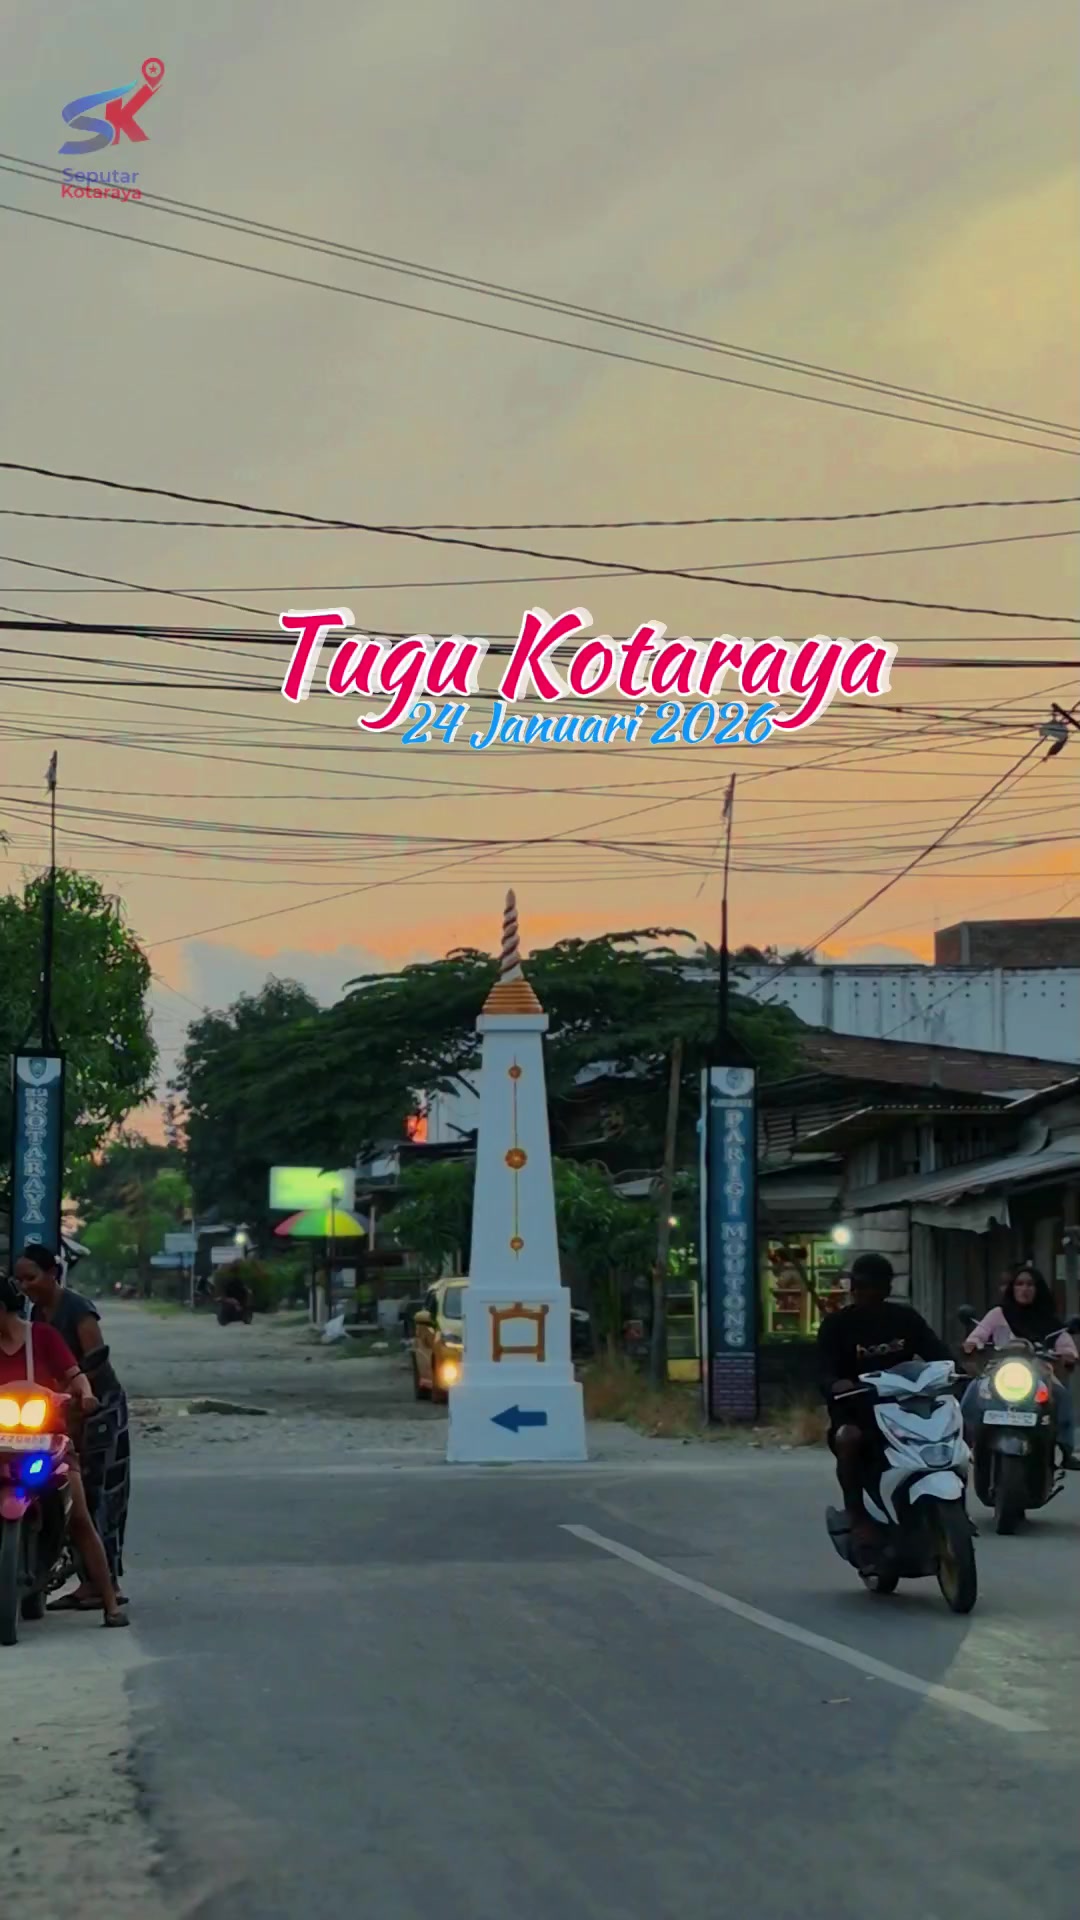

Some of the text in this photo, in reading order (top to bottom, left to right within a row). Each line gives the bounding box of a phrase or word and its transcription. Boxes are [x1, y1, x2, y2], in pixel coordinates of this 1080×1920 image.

[22, 1098, 47, 1224] KOTARAYA
[724, 1109, 745, 1215] PARIGI
[721, 1222, 747, 1346] MOUTONG
